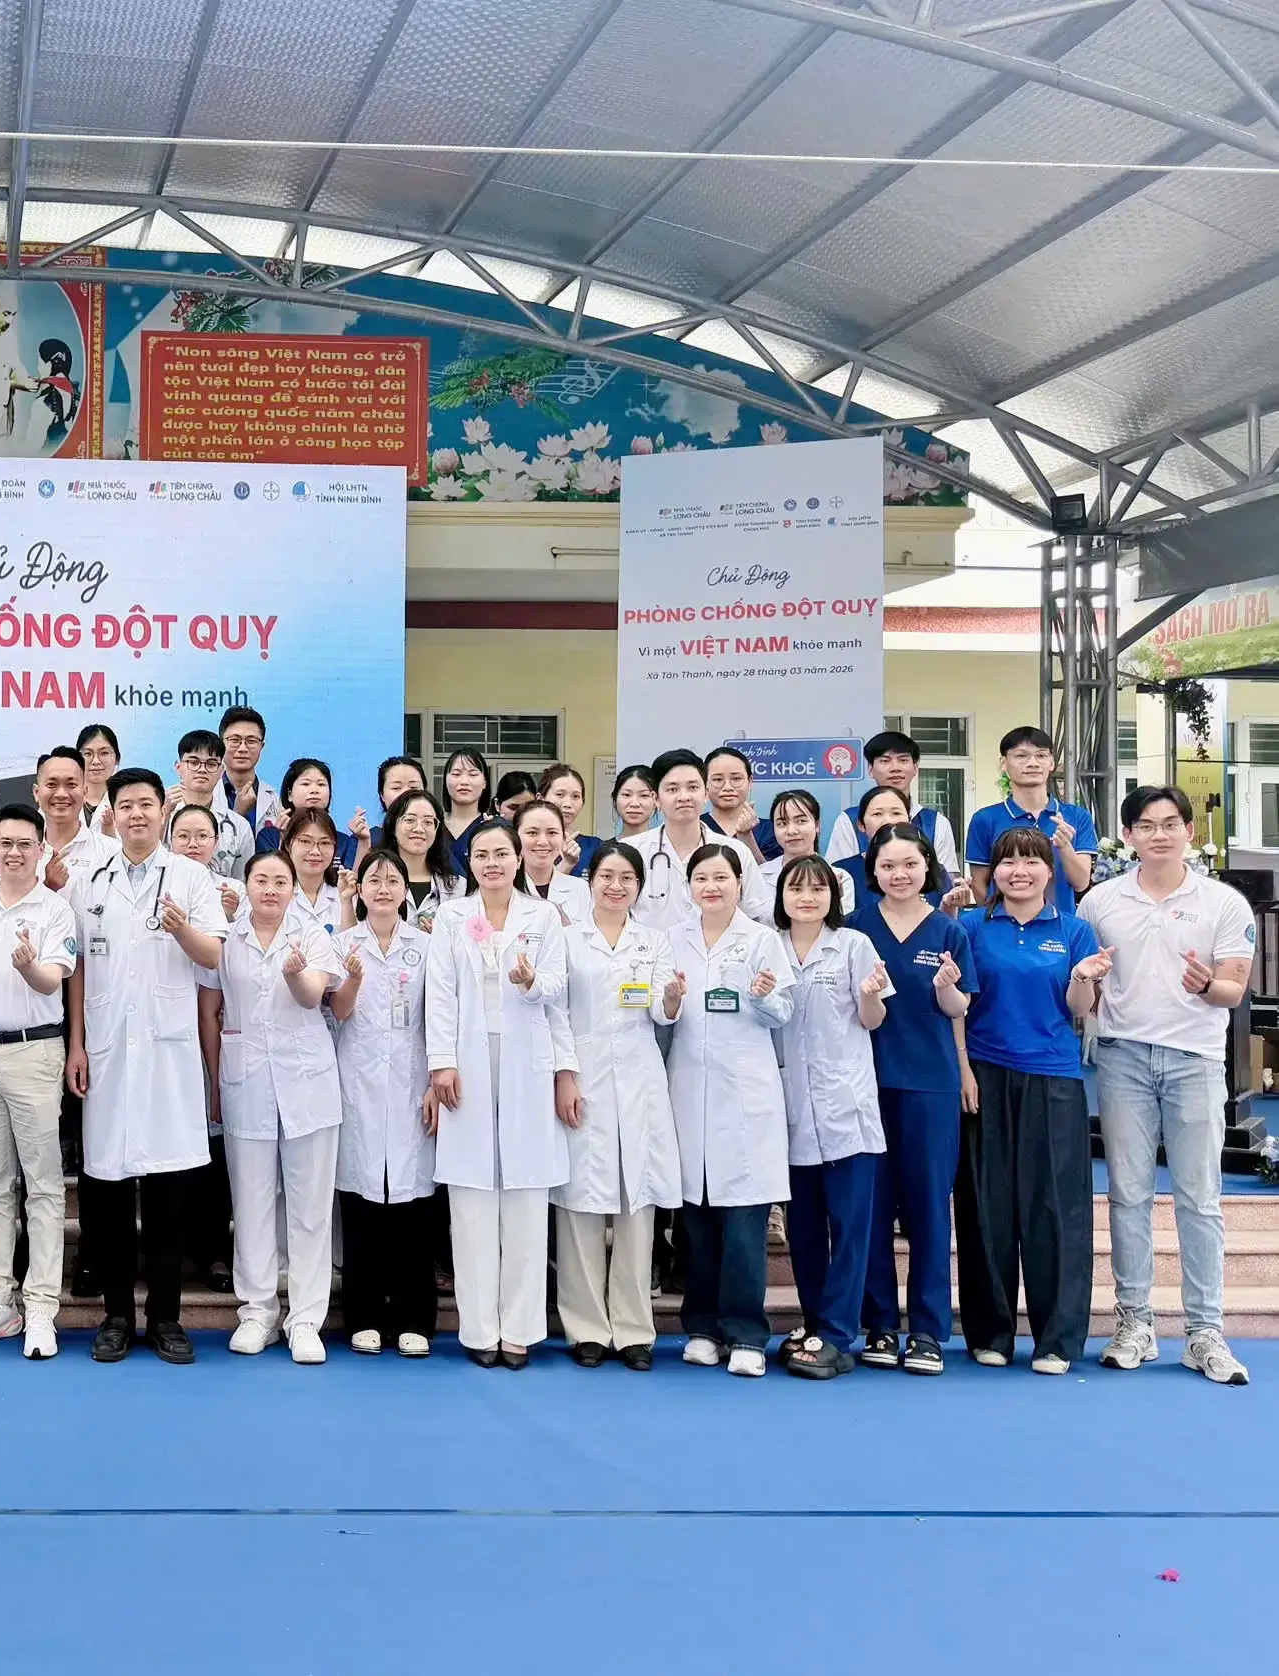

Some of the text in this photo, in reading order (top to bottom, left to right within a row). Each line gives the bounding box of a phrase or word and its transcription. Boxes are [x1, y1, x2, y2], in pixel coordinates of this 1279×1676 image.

[217, 347, 260, 360] sông
[265, 348, 301, 361] Việt
[306, 349, 348, 360] Nam
[353, 350, 375, 361] có
[380, 350, 406, 361] trở
[163, 361, 406, 377] nên tươi đẹp hay không, dân
[163, 375, 406, 390] tộc Việt Nam có bước tới đài
[163, 389, 406, 405] vinh quang để sánh vai với
[162, 447, 193, 459] của
[196, 449, 226, 460] các
[87, 490, 137, 501] LONG CHÂU
[170, 490, 222, 501] LONG CHÂU
[20, 541, 109, 604] Động
[706, 564, 790, 589] Chủ Động
[624, 597, 878, 625] PHÒNG CHỐNG ĐỘT QUỴ
[91, 604, 178, 659] ĐỘT
[188, 615, 278, 660] QUỴ
[638, 646, 650, 657] Vì
[653, 646, 676, 658] một
[679, 634, 730, 659] VIỆT
[735, 636, 789, 653] NAM
[827, 638, 862, 651] mạnh
[1, 671, 105, 709] NAM
[115, 683, 173, 706] khỏe
[181, 686, 248, 712] mạnh
[771, 757, 816, 775] KHOẺ
